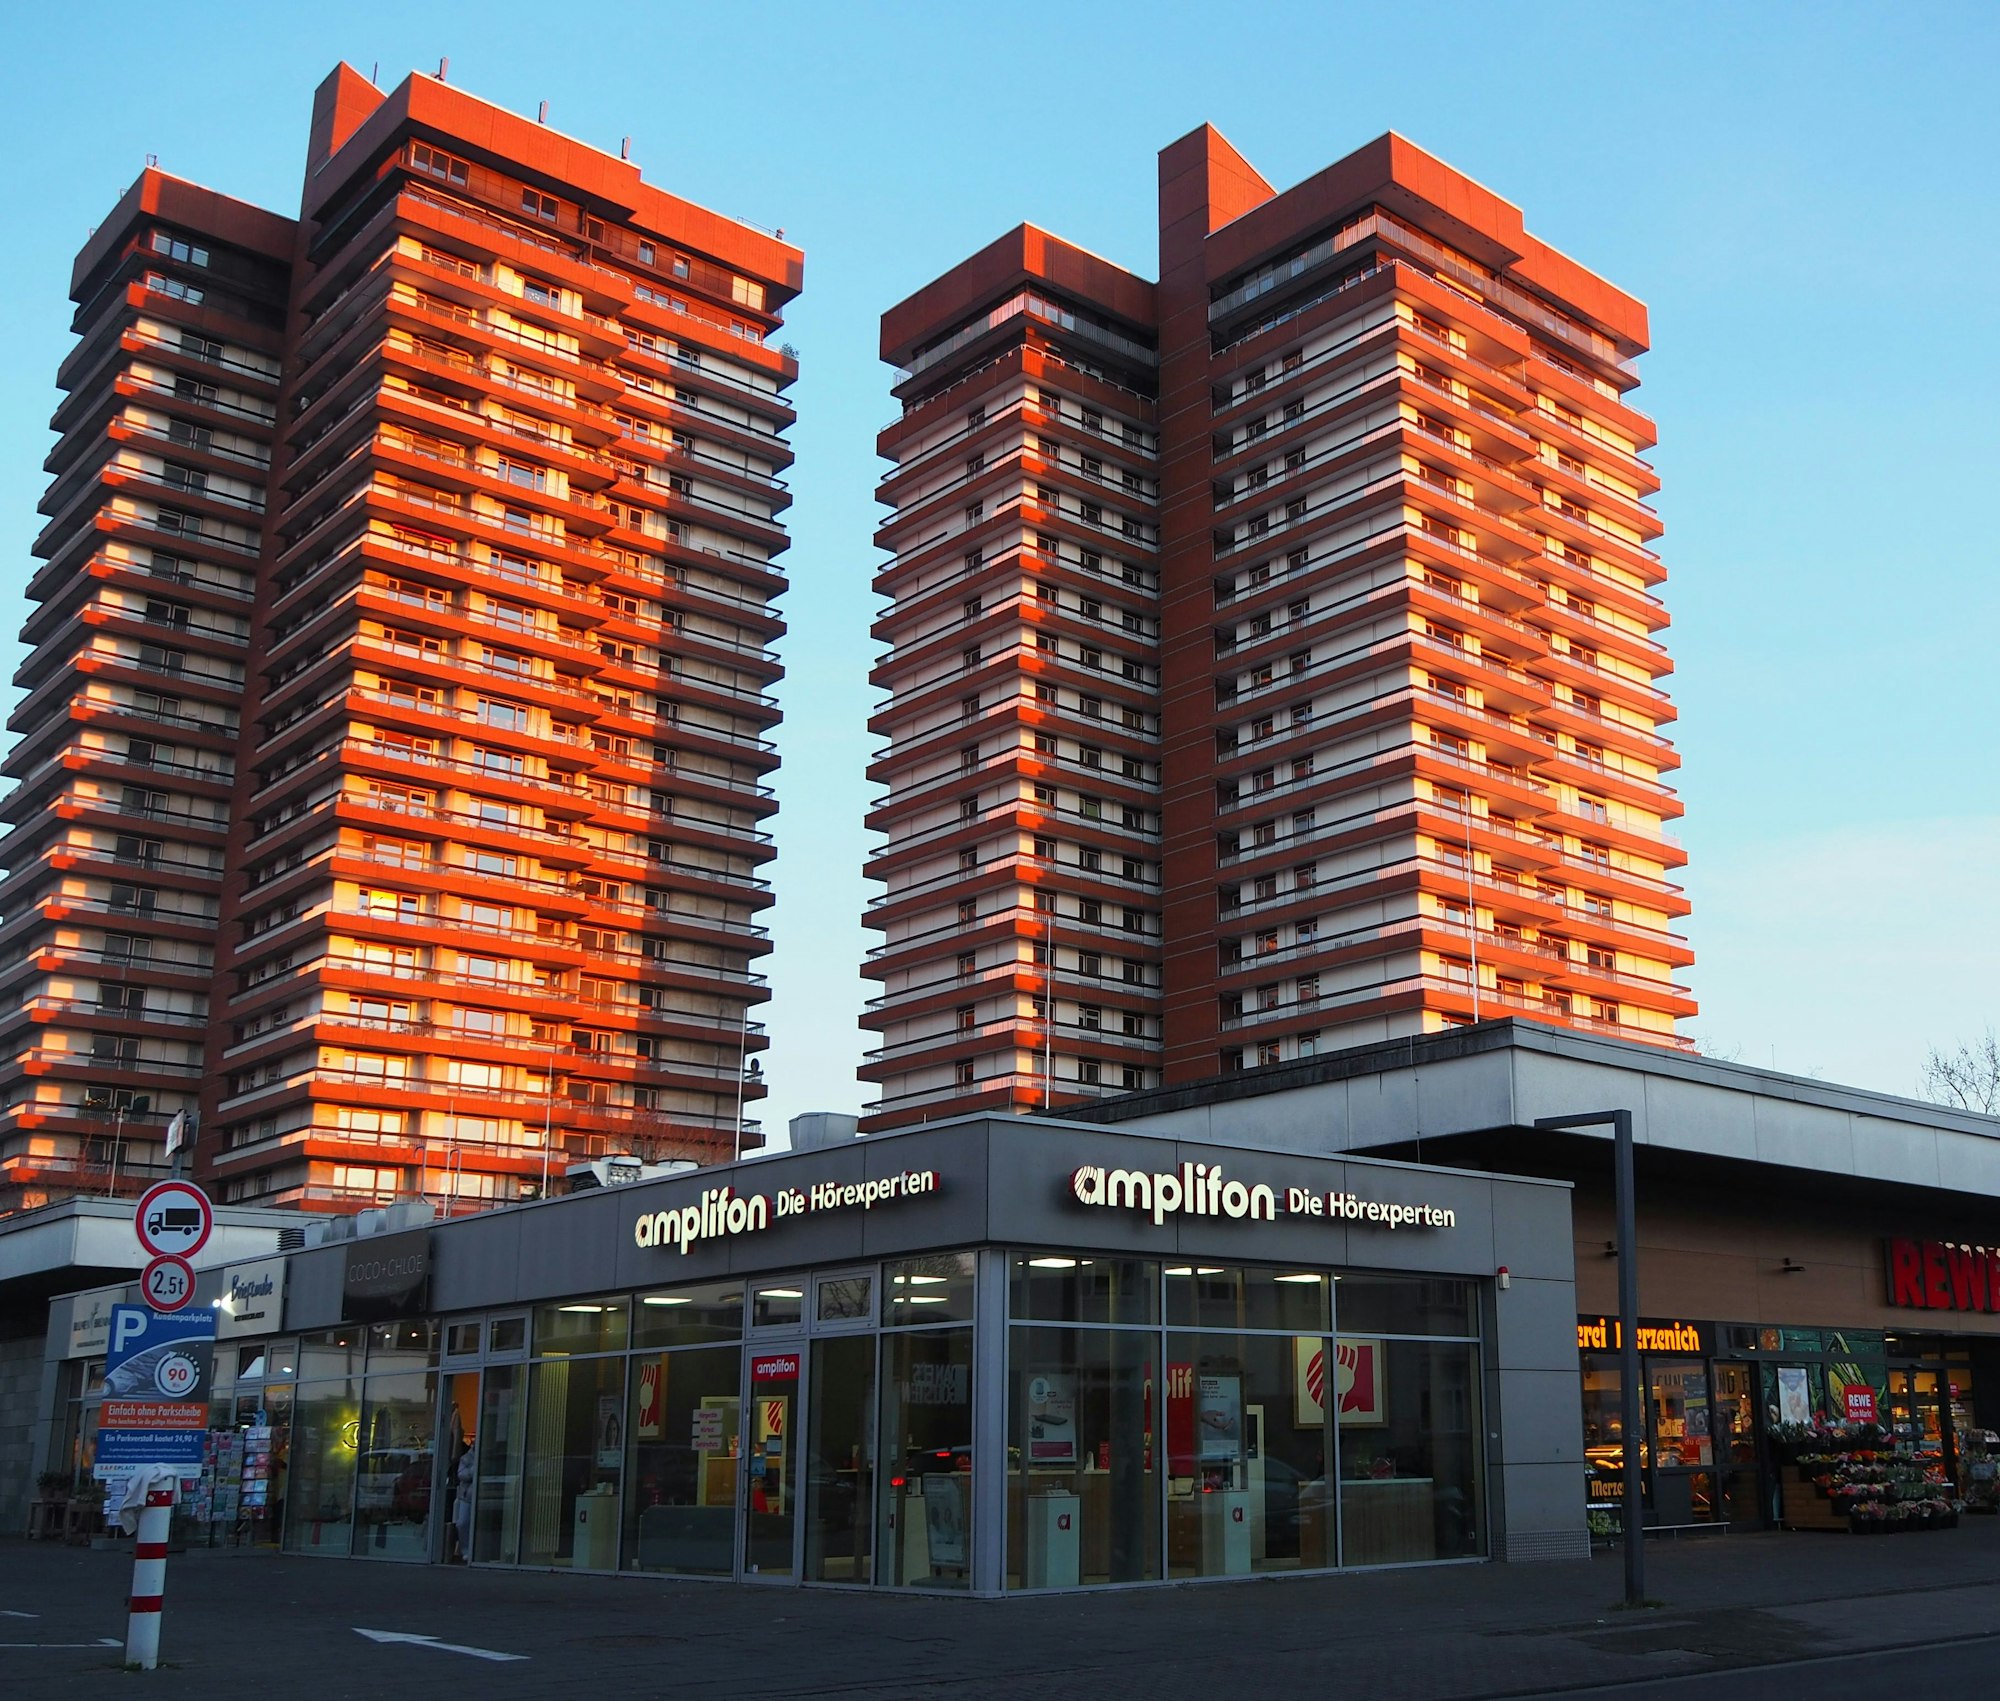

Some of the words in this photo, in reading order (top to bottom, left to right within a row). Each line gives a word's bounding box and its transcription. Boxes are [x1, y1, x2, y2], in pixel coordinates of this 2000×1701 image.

[1074, 1162, 1275, 1225] amplifon
[1289, 1187, 1322, 1215] Die
[1330, 1192, 1455, 1229] Hörexperten
[635, 1186, 767, 1255] amplifon
[777, 1188, 805, 1217] Die
[811, 1170, 934, 1210] Hörexperten
[153, 1312, 212, 1323] Kundenparkplatz
[114, 1310, 147, 1352] P
[757, 1359, 795, 1376] amplifon
[168, 1369, 187, 1381] 90
[1848, 1394, 1871, 1407] REWE
[108, 1404, 135, 1416] Einfach
[137, 1406, 156, 1416] ohne
[158, 1406, 201, 1417] Parkscheibe
[105, 1434, 115, 1442] Ein
[116, 1434, 153, 1442] Parkverstoß
[155, 1434, 174, 1442] kostet
[175, 1435, 192, 1443] 24,90
